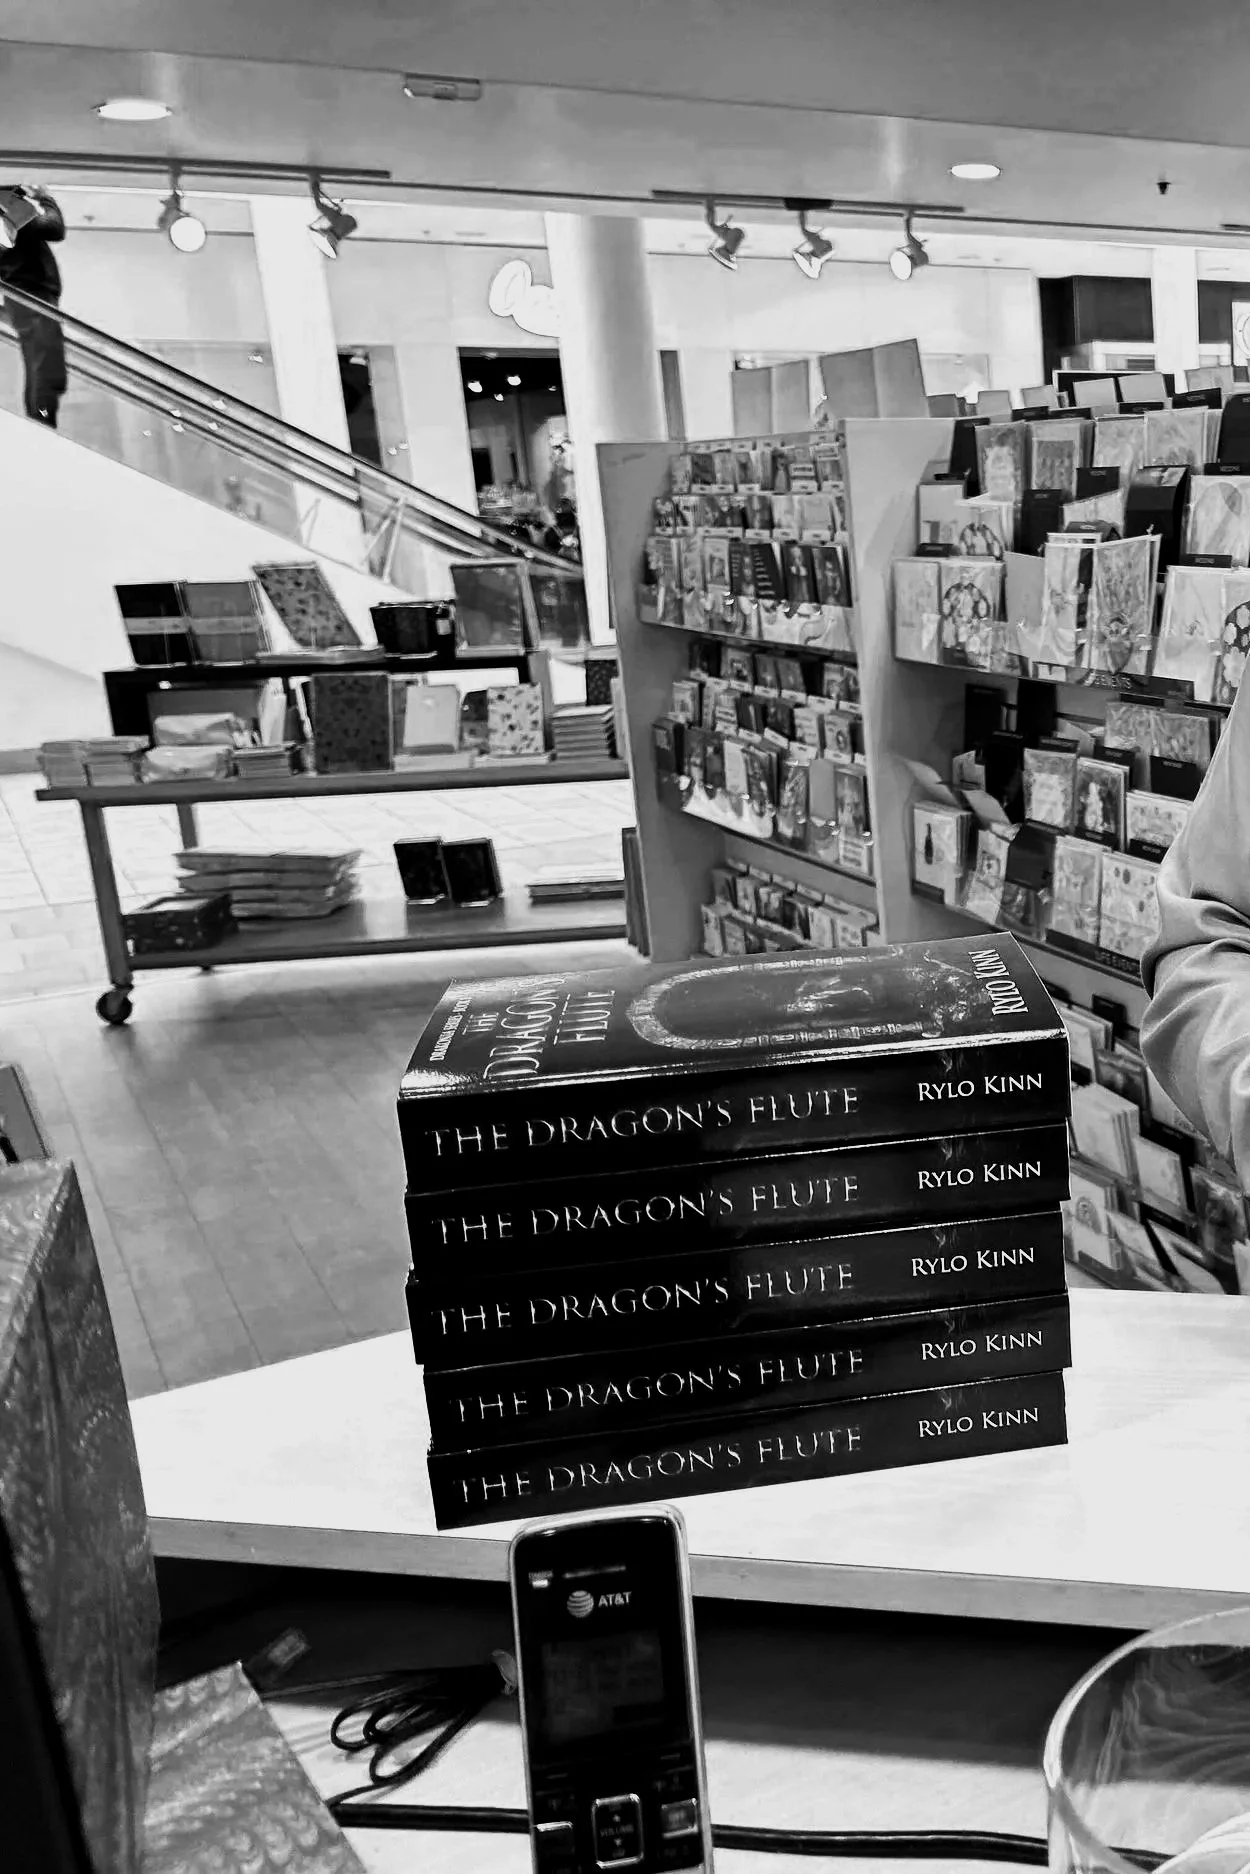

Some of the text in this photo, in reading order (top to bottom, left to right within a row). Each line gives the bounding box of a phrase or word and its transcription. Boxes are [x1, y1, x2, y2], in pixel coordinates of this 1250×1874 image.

[968, 948, 1029, 1016] RYLO KINN
[554, 989, 616, 1046] FLUTE
[917, 1072, 1043, 1102] RYLO KINN
[424, 1087, 859, 1156] THE DRAGON'S FLUTE
[917, 1160, 1042, 1190] RYLO KINN
[430, 1175, 859, 1244] THE DRAGON'S FLUTE
[911, 1247, 1035, 1277] RYLO KINN
[430, 1263, 853, 1335] THE DRAGON'S FLUTE
[920, 1330, 1043, 1361] RYLO KINN
[448, 1349, 864, 1423] THE DRAGON'S FLUTE
[918, 1407, 1039, 1438] RYLO KINN
[452, 1426, 862, 1503] THE DRAGON'S FLUTE
[598, 1591, 633, 1608] AT&T
